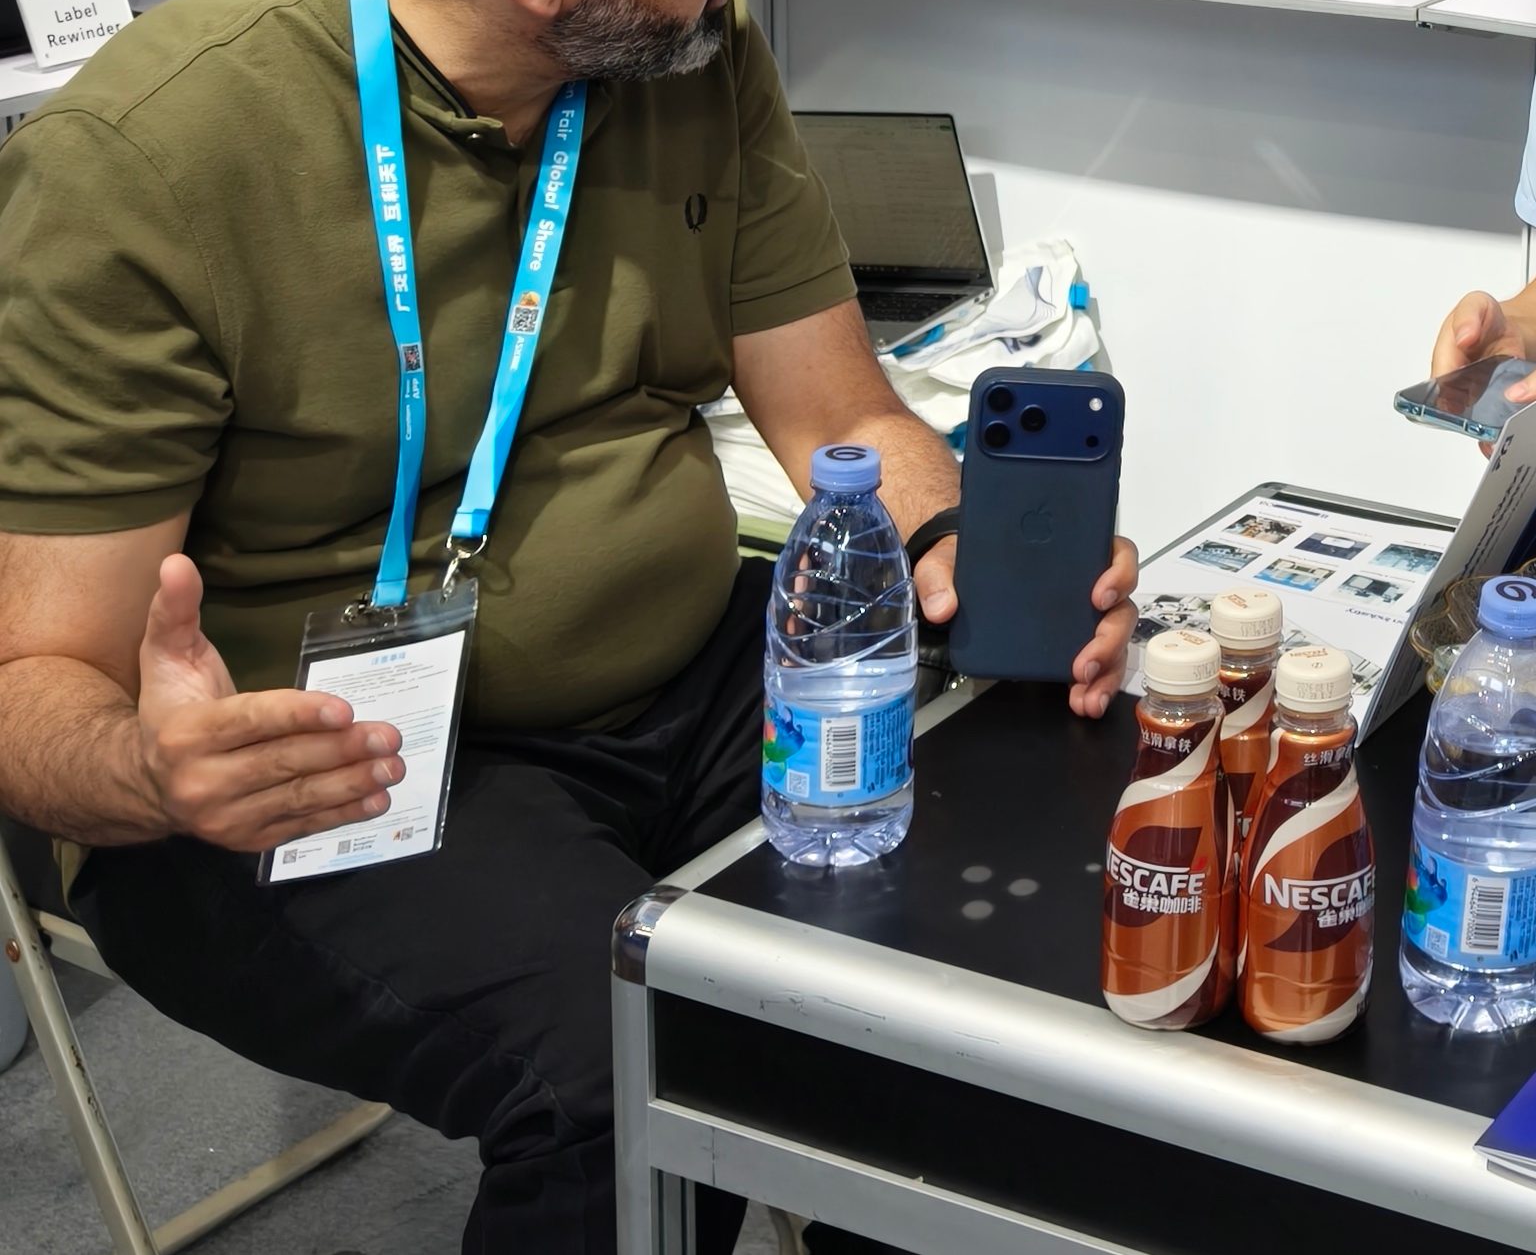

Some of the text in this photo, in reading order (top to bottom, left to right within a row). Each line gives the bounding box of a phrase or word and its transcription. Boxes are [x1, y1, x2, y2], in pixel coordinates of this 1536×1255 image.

[54, 2, 98, 24] Label
[47, 23, 121, 48] Rewinder
[556, 110, 575, 140] Fair
[544, 151, 569, 210] Global
[528, 219, 555, 272] Share
[387, 234, 411, 313] 广交世界
[1122, 888, 1202, 915] 雀巢咖啡
